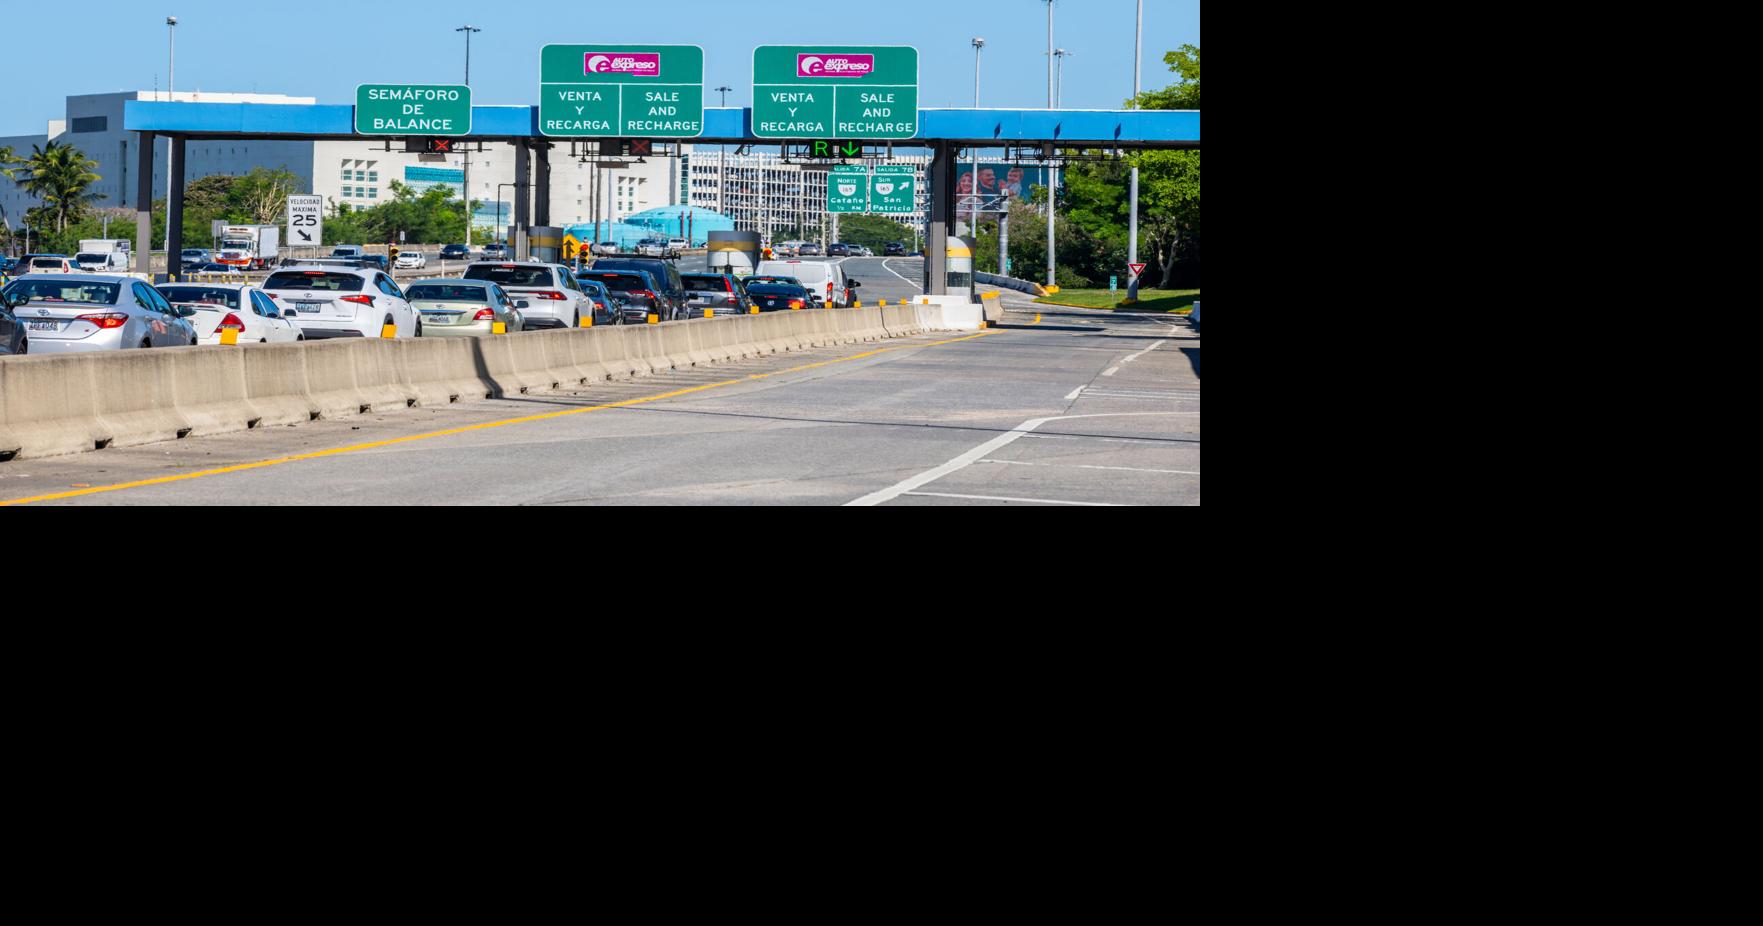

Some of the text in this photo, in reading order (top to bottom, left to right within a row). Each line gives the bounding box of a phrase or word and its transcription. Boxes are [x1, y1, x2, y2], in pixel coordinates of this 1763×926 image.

[368, 87, 459, 101] SEMÁFORO
[558, 91, 602, 101] VENTA
[645, 91, 680, 102] SALE
[770, 92, 814, 103] VENTA
[860, 93, 895, 103] SALE
[402, 104, 424, 115] DE
[575, 106, 584, 115] Y
[648, 106, 677, 116] AND
[788, 107, 797, 117] Y
[862, 108, 891, 118] AND
[373, 118, 452, 130] BALANCE
[547, 120, 610, 130] RECARGA
[627, 121, 699, 131] RECHARGE
[760, 121, 824, 132] RECARGA
[838, 122, 913, 133] RECHARGE
[815, 141, 828, 156] R
[292, 214, 317, 227] 25
